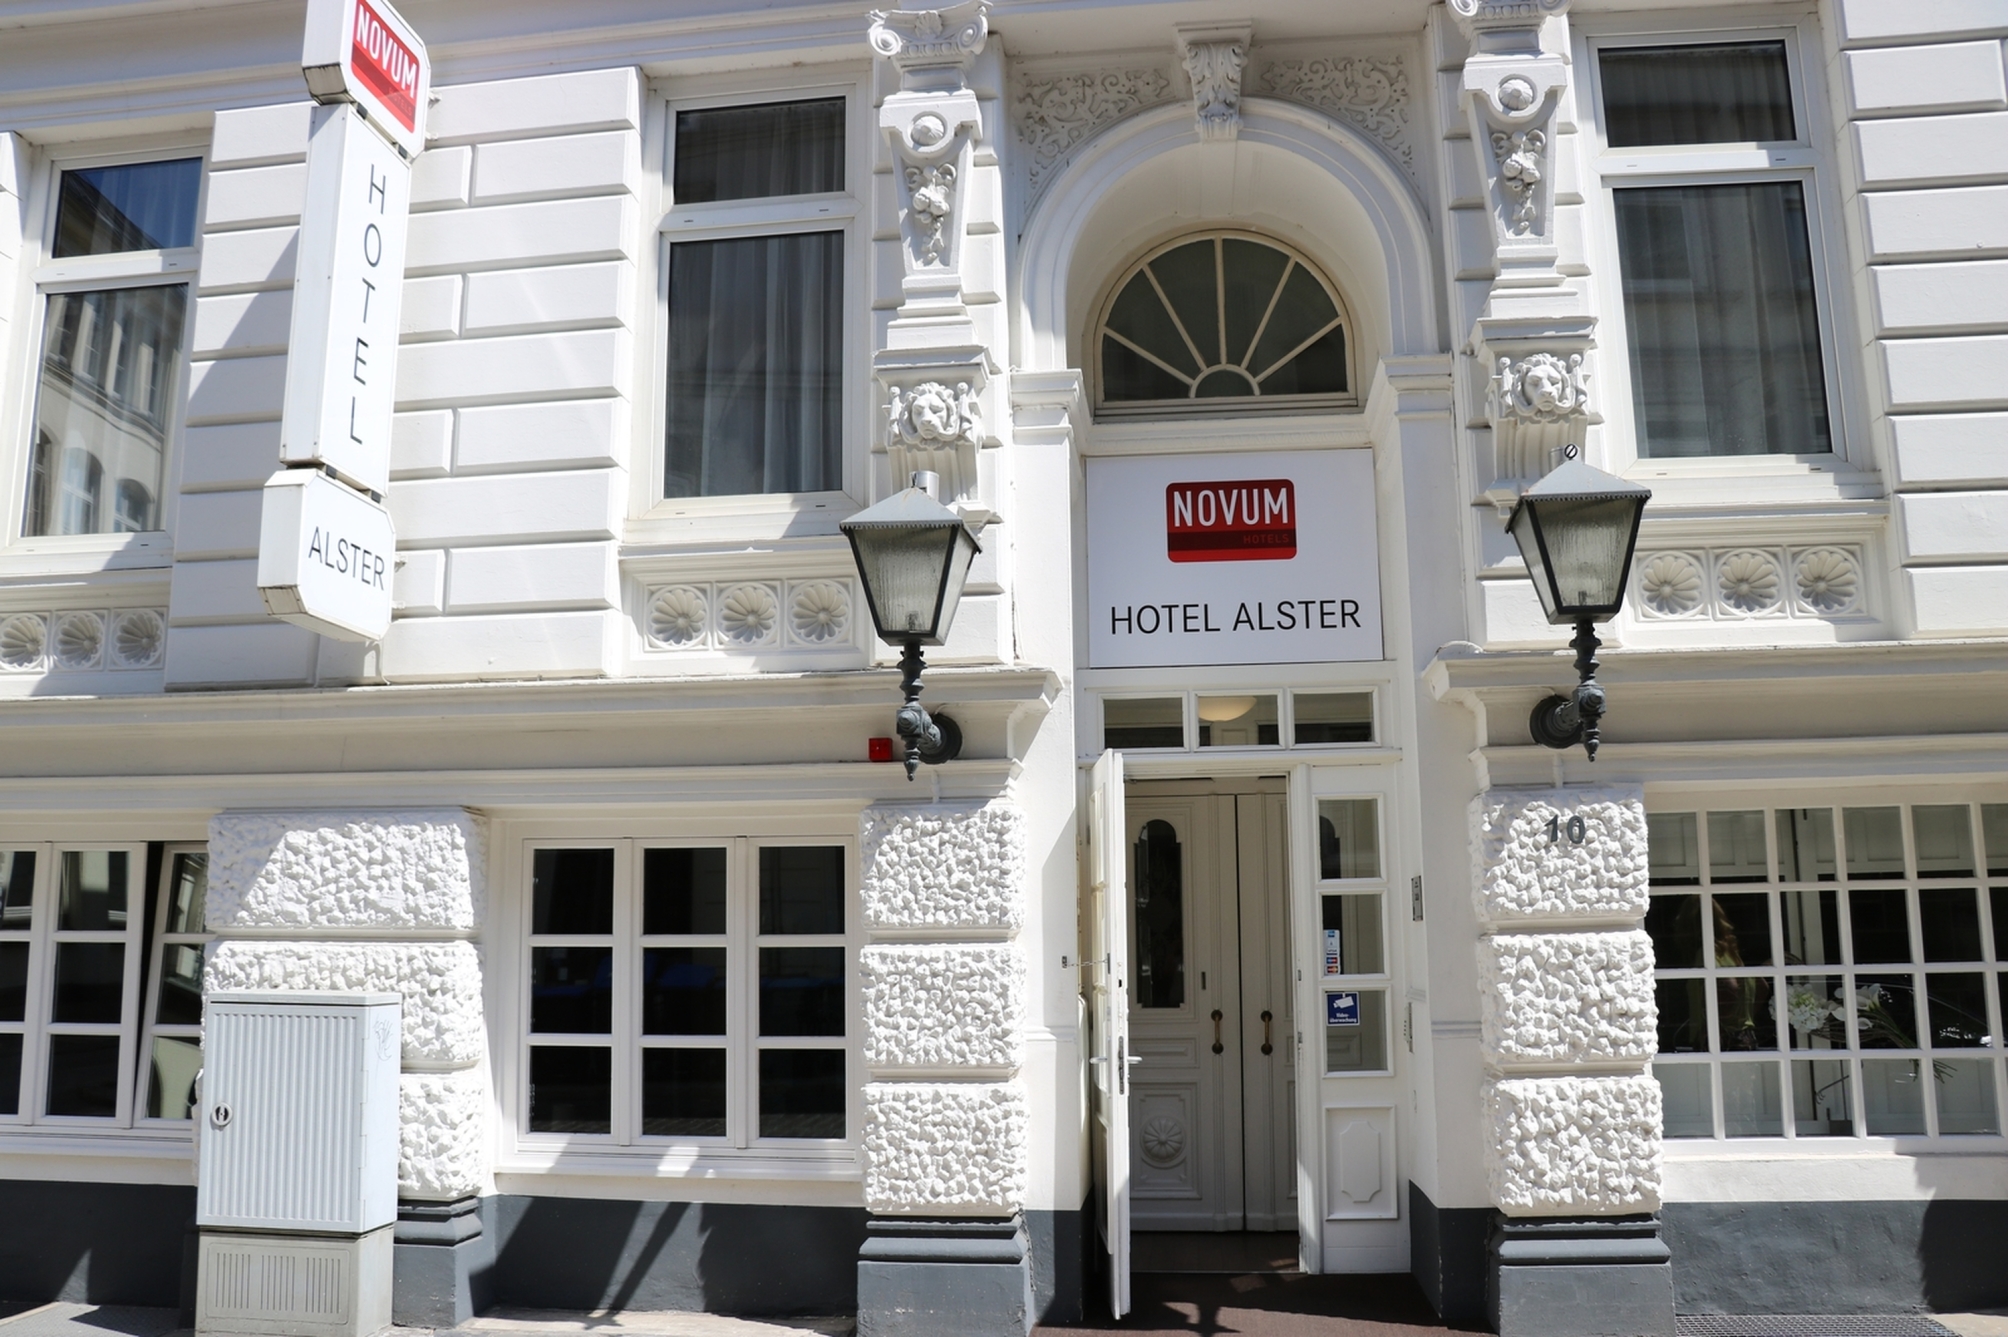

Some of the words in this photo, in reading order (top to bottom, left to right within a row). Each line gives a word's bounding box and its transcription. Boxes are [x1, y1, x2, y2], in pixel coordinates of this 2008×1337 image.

[356, 4, 418, 99] NOVUM
[349, 163, 387, 445] HOTEL
[1173, 487, 1289, 527] NOVUM
[308, 526, 385, 591] ALSTER
[1243, 533, 1290, 545] HOTELS
[1111, 603, 1221, 635] HOTEL
[1232, 600, 1362, 632] ALSTER
[1544, 814, 1586, 844] 10
